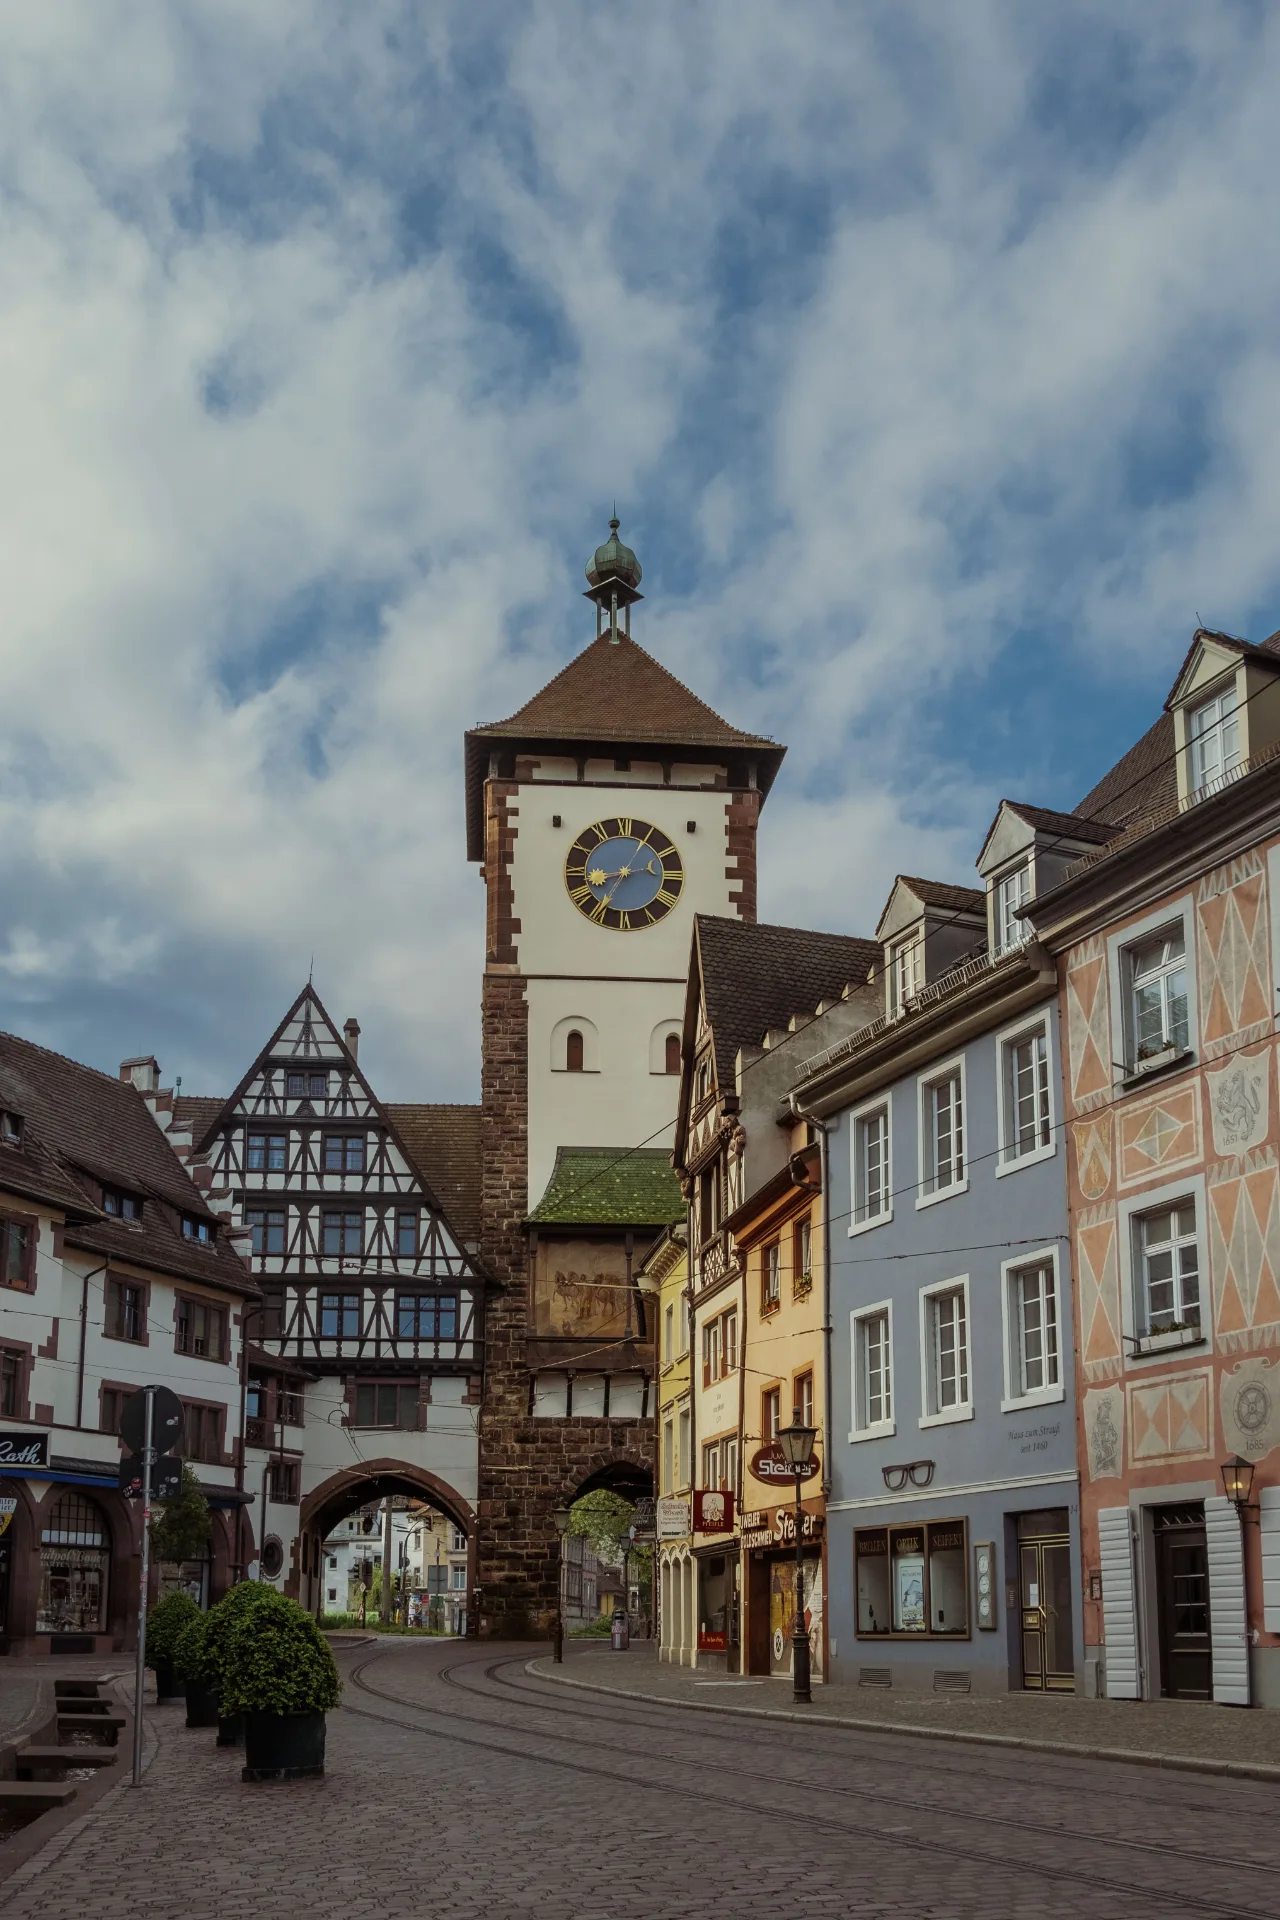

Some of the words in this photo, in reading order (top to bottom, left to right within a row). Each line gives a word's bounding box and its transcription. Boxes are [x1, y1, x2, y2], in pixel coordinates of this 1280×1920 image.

[617, 818, 632, 836] XII
[1222, 1134, 1238, 1146] 1651
[1007, 1429, 1024, 1440] Haus
[1025, 1429, 1038, 1438] zum
[1038, 1421, 1061, 1436] Strauß
[1020, 1443, 1031, 1453] seit
[1244, 1439, 1264, 1451] 1685
[773, 1509, 816, 1541] Steier
[858, 1540, 886, 1552] BRILLEN
[896, 1537, 919, 1550] OPTIK
[932, 1533, 963, 1547] SEIFERT
